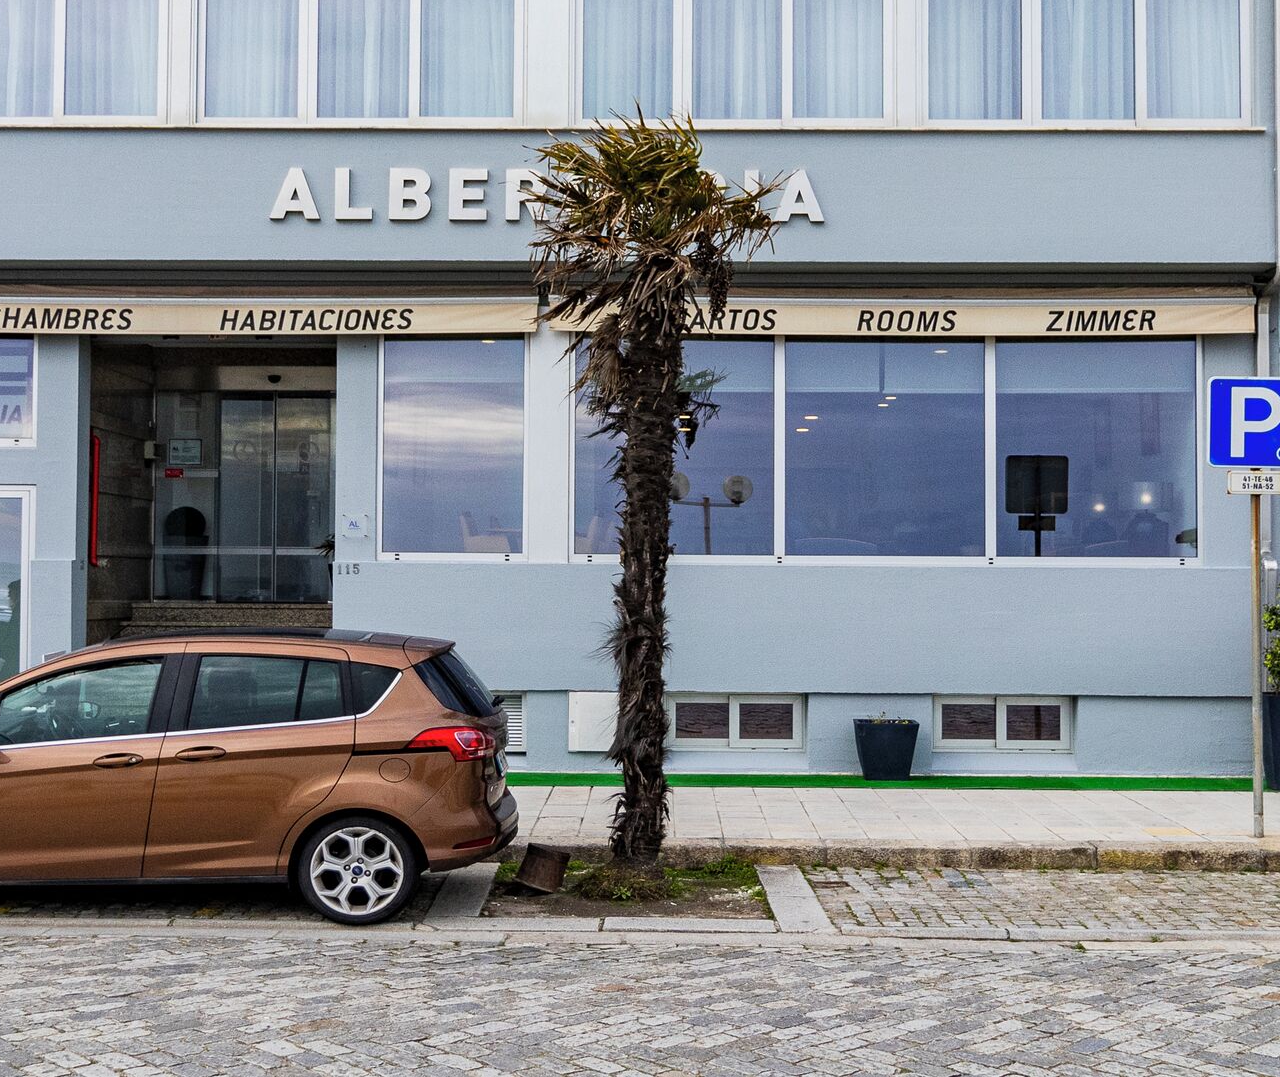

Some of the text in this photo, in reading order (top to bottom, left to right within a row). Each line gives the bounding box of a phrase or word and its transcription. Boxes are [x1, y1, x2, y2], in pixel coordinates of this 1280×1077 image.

[269, 167, 825, 223] ALBERIA
[220, 309, 414, 331] HABITACIONES
[857, 310, 957, 332] ROOMS
[1046, 310, 1156, 331] ZIMMER
[337, 563, 360, 575] 115
